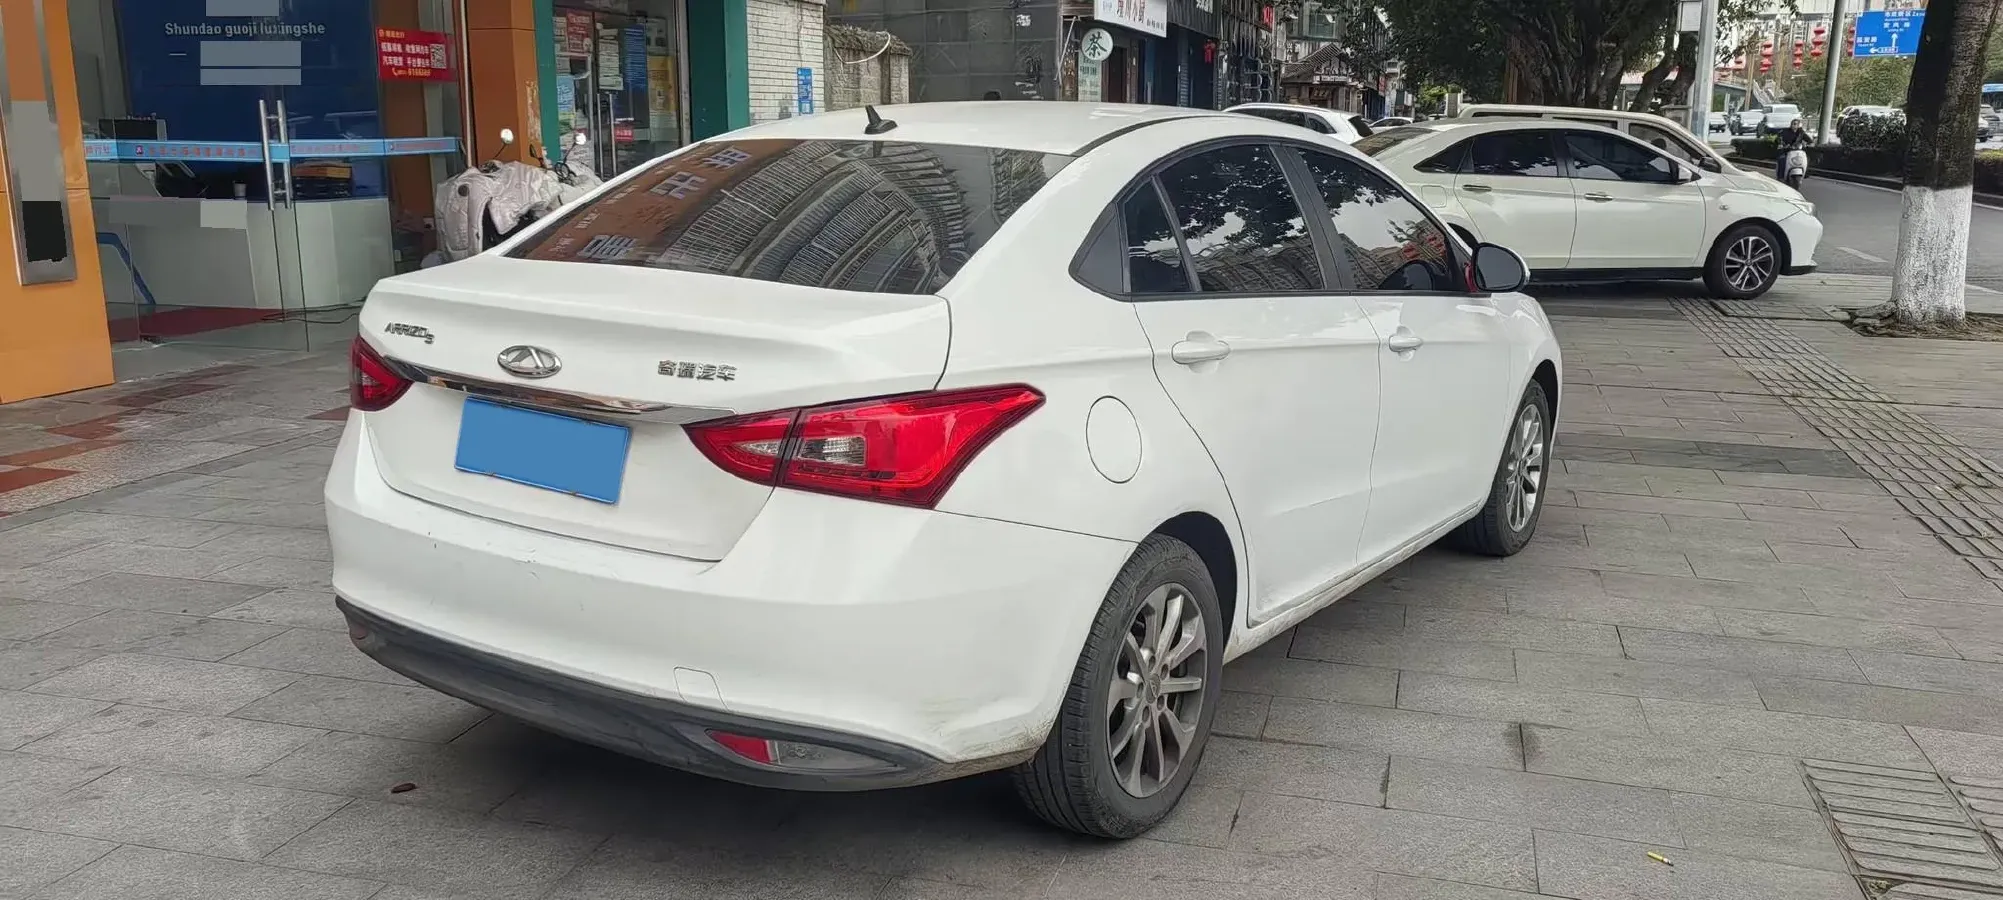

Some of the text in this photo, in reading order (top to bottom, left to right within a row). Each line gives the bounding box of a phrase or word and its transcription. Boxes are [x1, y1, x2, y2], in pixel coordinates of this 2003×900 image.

[164, 22, 222, 35] Shundao
[225, 22, 257, 37] guoji
[1085, 31, 1107, 57] 茶
[657, 359, 737, 381] 奇瑞汽车
